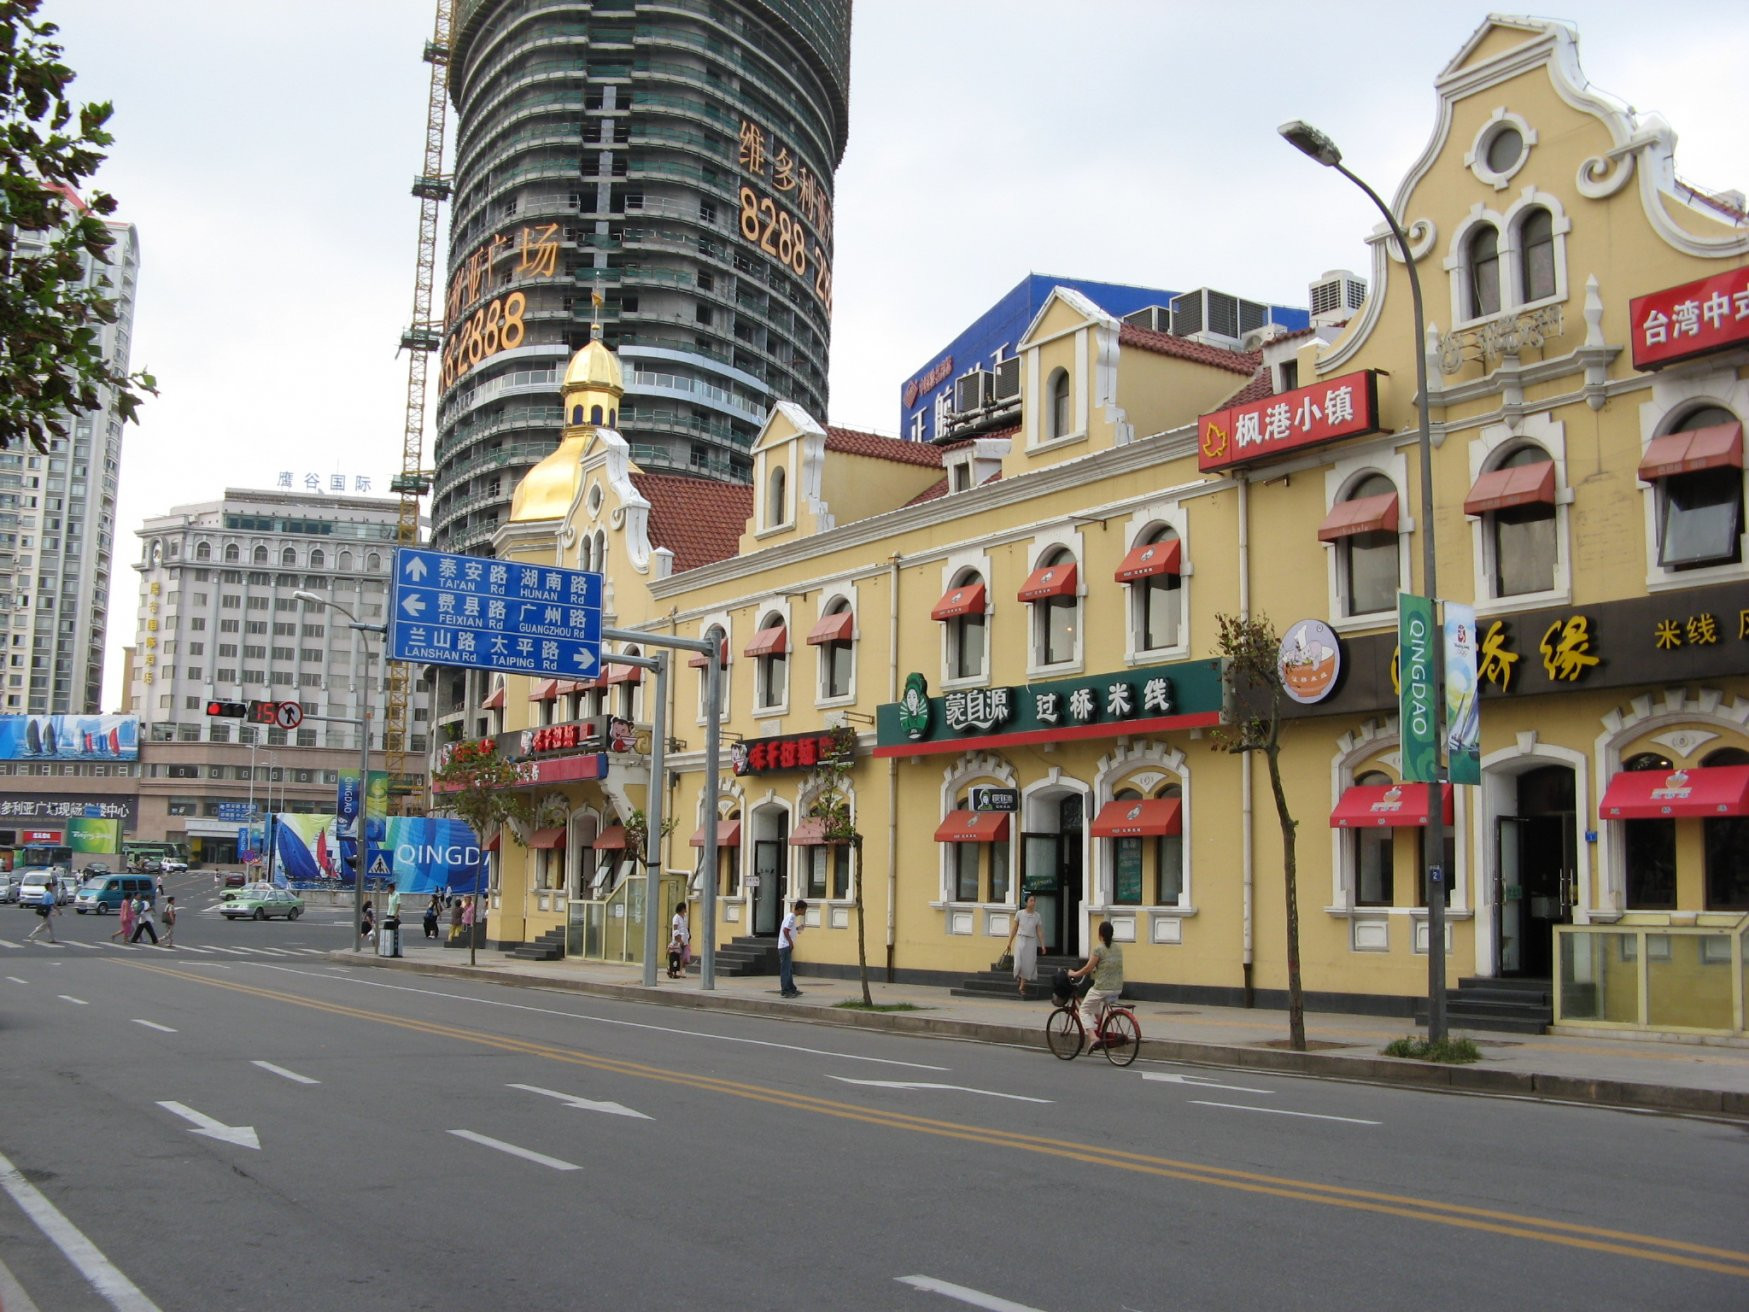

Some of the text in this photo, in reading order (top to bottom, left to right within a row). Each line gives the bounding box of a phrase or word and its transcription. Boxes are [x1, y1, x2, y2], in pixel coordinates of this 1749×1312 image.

[740, 187, 806, 276] 8288
[458, 291, 527, 377] 2888
[1235, 386, 1354, 448] 枫港小镇
[438, 578, 585, 604] TAI'AN Rd HUNAN Rd
[439, 558, 588, 595] 泰安路 湖南路
[437, 593, 587, 628] 费县路 广州路
[439, 614, 585, 639] FEIXIAN Rd GUANGZHOU Rd
[408, 627, 558, 660] 兰山路 太平路
[1655, 613, 1718, 650] 米线
[405, 646, 557, 671] LANSHAN Rd TAIPING Rd
[1409, 619, 1427, 735] QINGDAO
[257, 703, 274, 724] 15
[945, 676, 1171, 729] 蒙自源 过桥米线
[344, 777, 353, 813] QINGDAO
